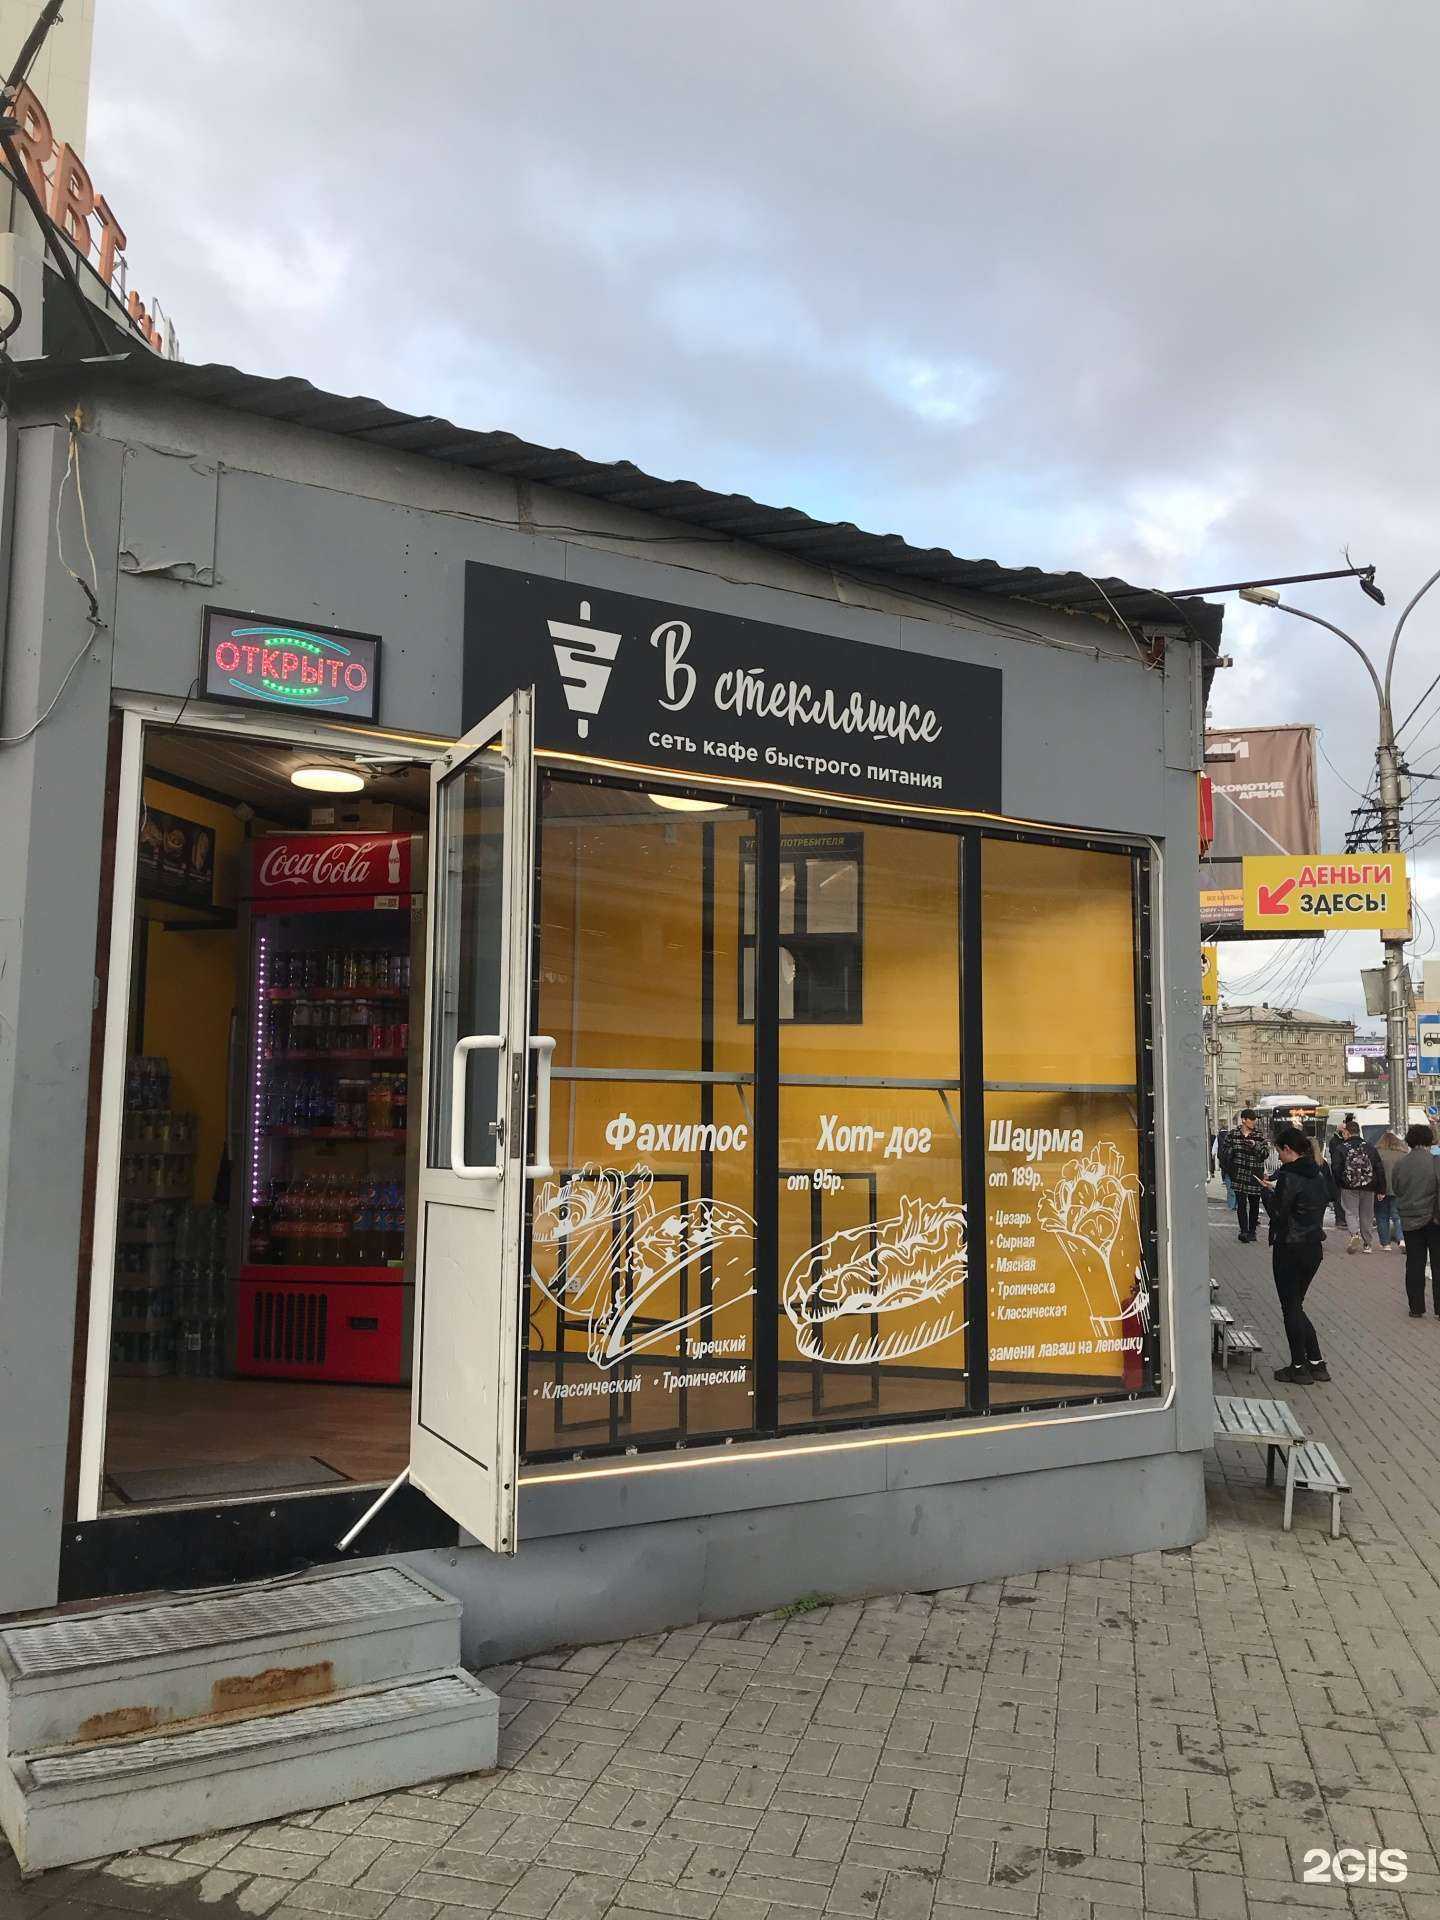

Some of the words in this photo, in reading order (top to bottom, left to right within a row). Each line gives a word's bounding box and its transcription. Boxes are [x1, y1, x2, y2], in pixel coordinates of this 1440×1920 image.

[215, 641, 368, 692] ОТКРЫТО
[650, 620, 697, 711] В
[714, 667, 943, 744] стекляшке
[648, 731, 697, 752] сеть
[703, 738, 758, 763] кафе
[765, 746, 861, 779] быстрого
[867, 765, 943, 790] питания
[259, 842, 378, 887] Coca-Cola
[1299, 864, 1392, 888] ДЕНЬГИ
[1300, 893, 1387, 915] ЗДЕСЬ!
[605, 1113, 748, 1152] Фахитос
[816, 1114, 932, 1159] Хот-дог
[988, 1119, 1084, 1161] Шаурма
[787, 1174, 809, 1190] от
[813, 1168, 845, 1196] 95р.
[988, 1171, 1008, 1187] от
[1011, 1166, 1044, 1191] 189р.
[995, 1210, 1031, 1228] Цезарь
[996, 1233, 1035, 1251] Сырная
[996, 1257, 1036, 1273] Мясная
[685, 1335, 746, 1360] Турецкий
[989, 1345, 1035, 1361] замени
[1038, 1342, 1075, 1358] лаваш
[1078, 1341, 1092, 1355] на
[1095, 1336, 1144, 1354] лепешку
[542, 1374, 642, 1400] Классический
[663, 1365, 746, 1393] Тропический
